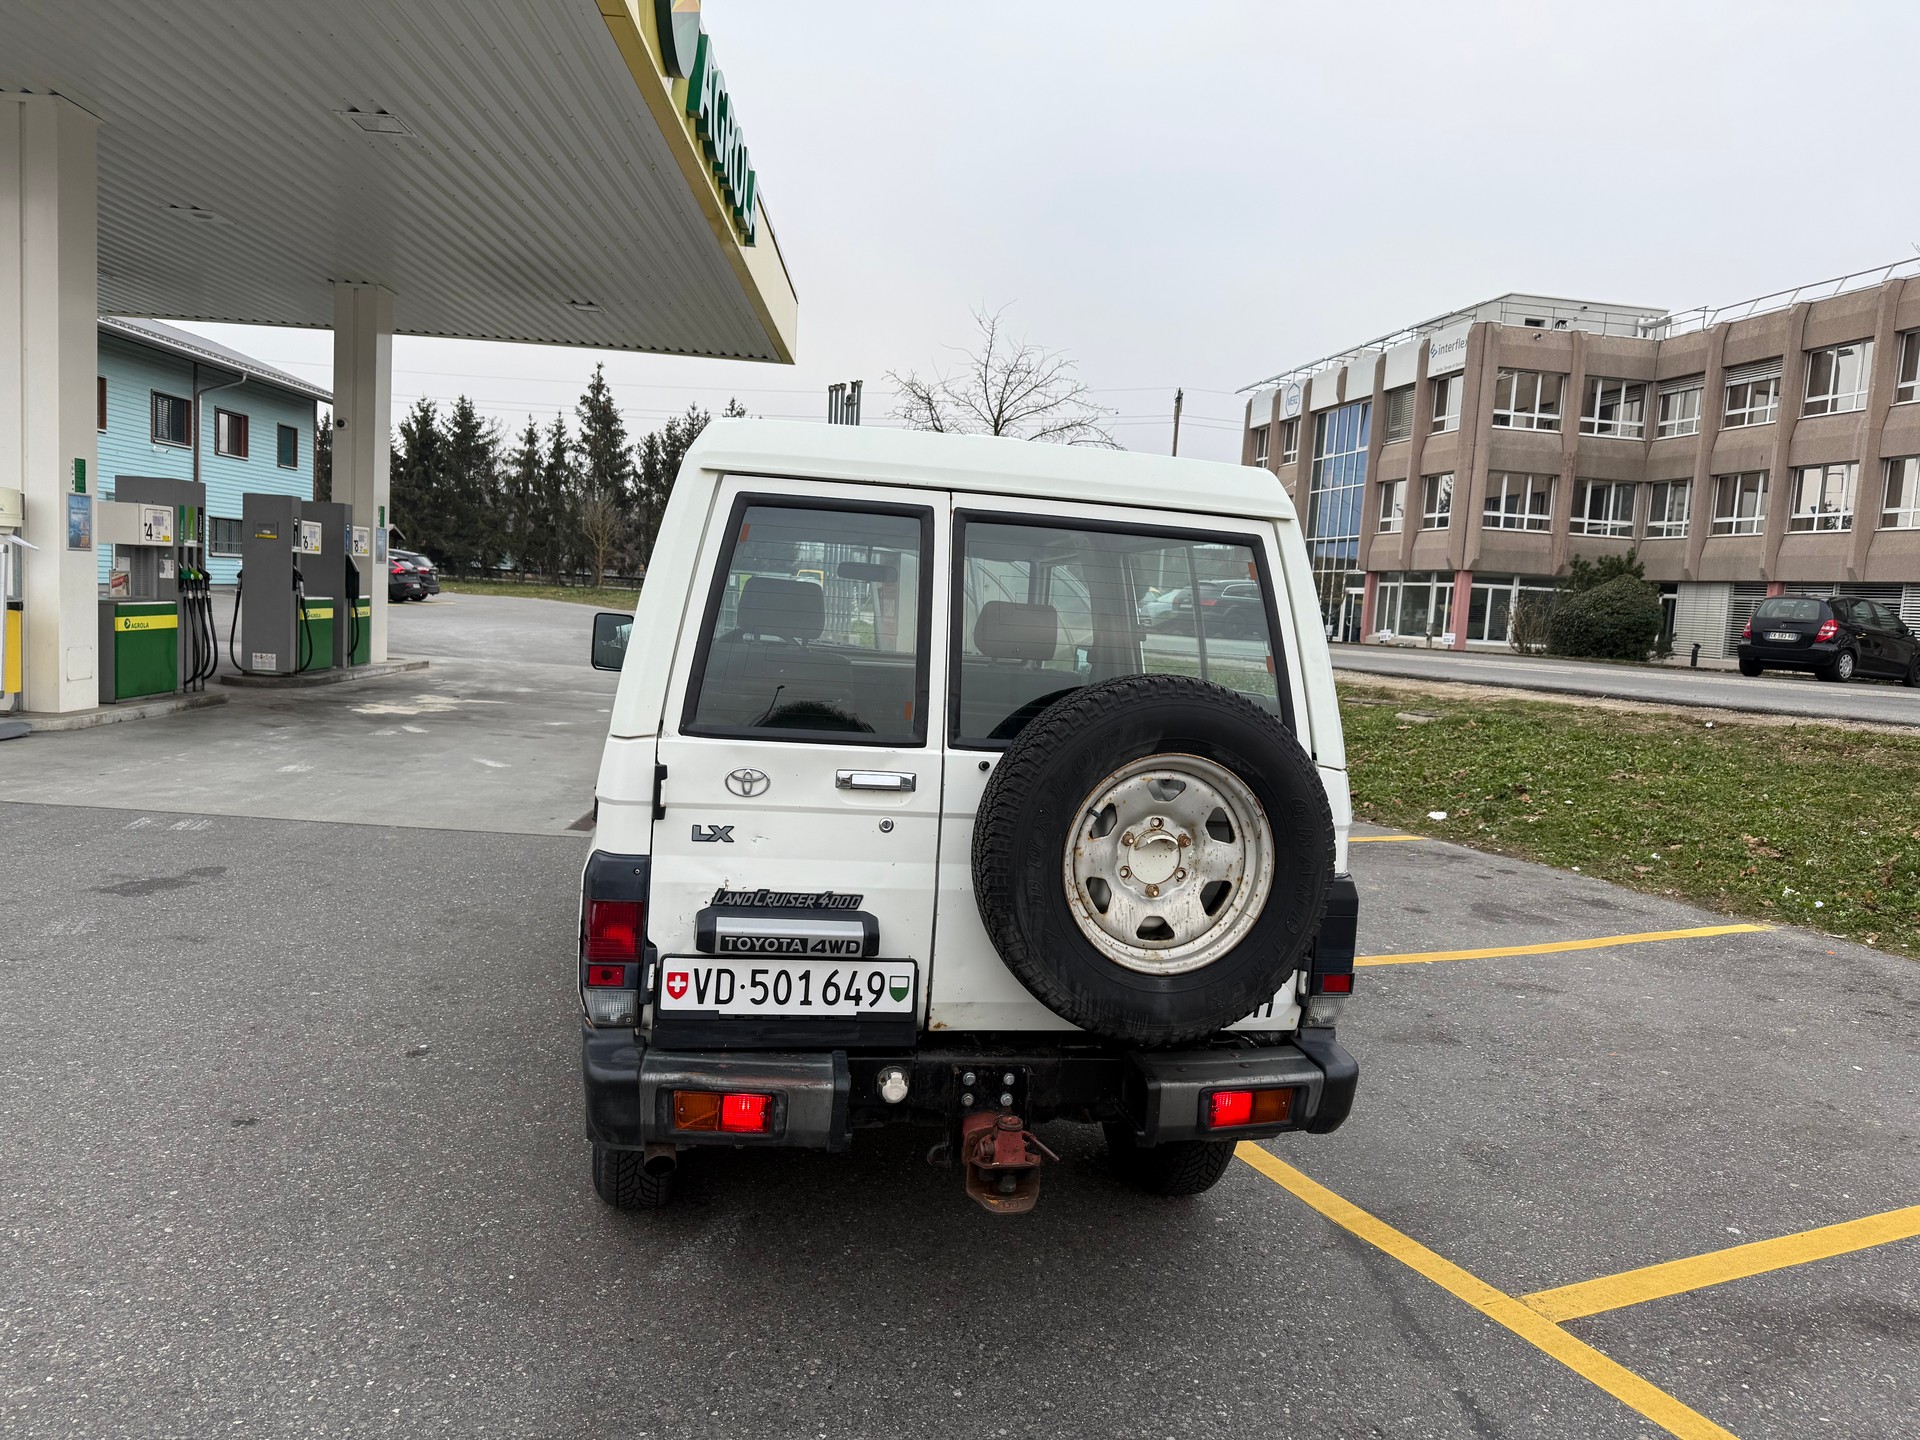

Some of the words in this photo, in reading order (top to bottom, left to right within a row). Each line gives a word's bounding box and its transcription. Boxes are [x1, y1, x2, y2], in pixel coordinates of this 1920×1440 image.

[687, 33, 757, 247] AGROLA
[691, 824, 735, 843] LX
[752, 889, 816, 909] CRUISER
[724, 936, 804, 953] TOYOTA
[810, 939, 862, 955] 4WD
